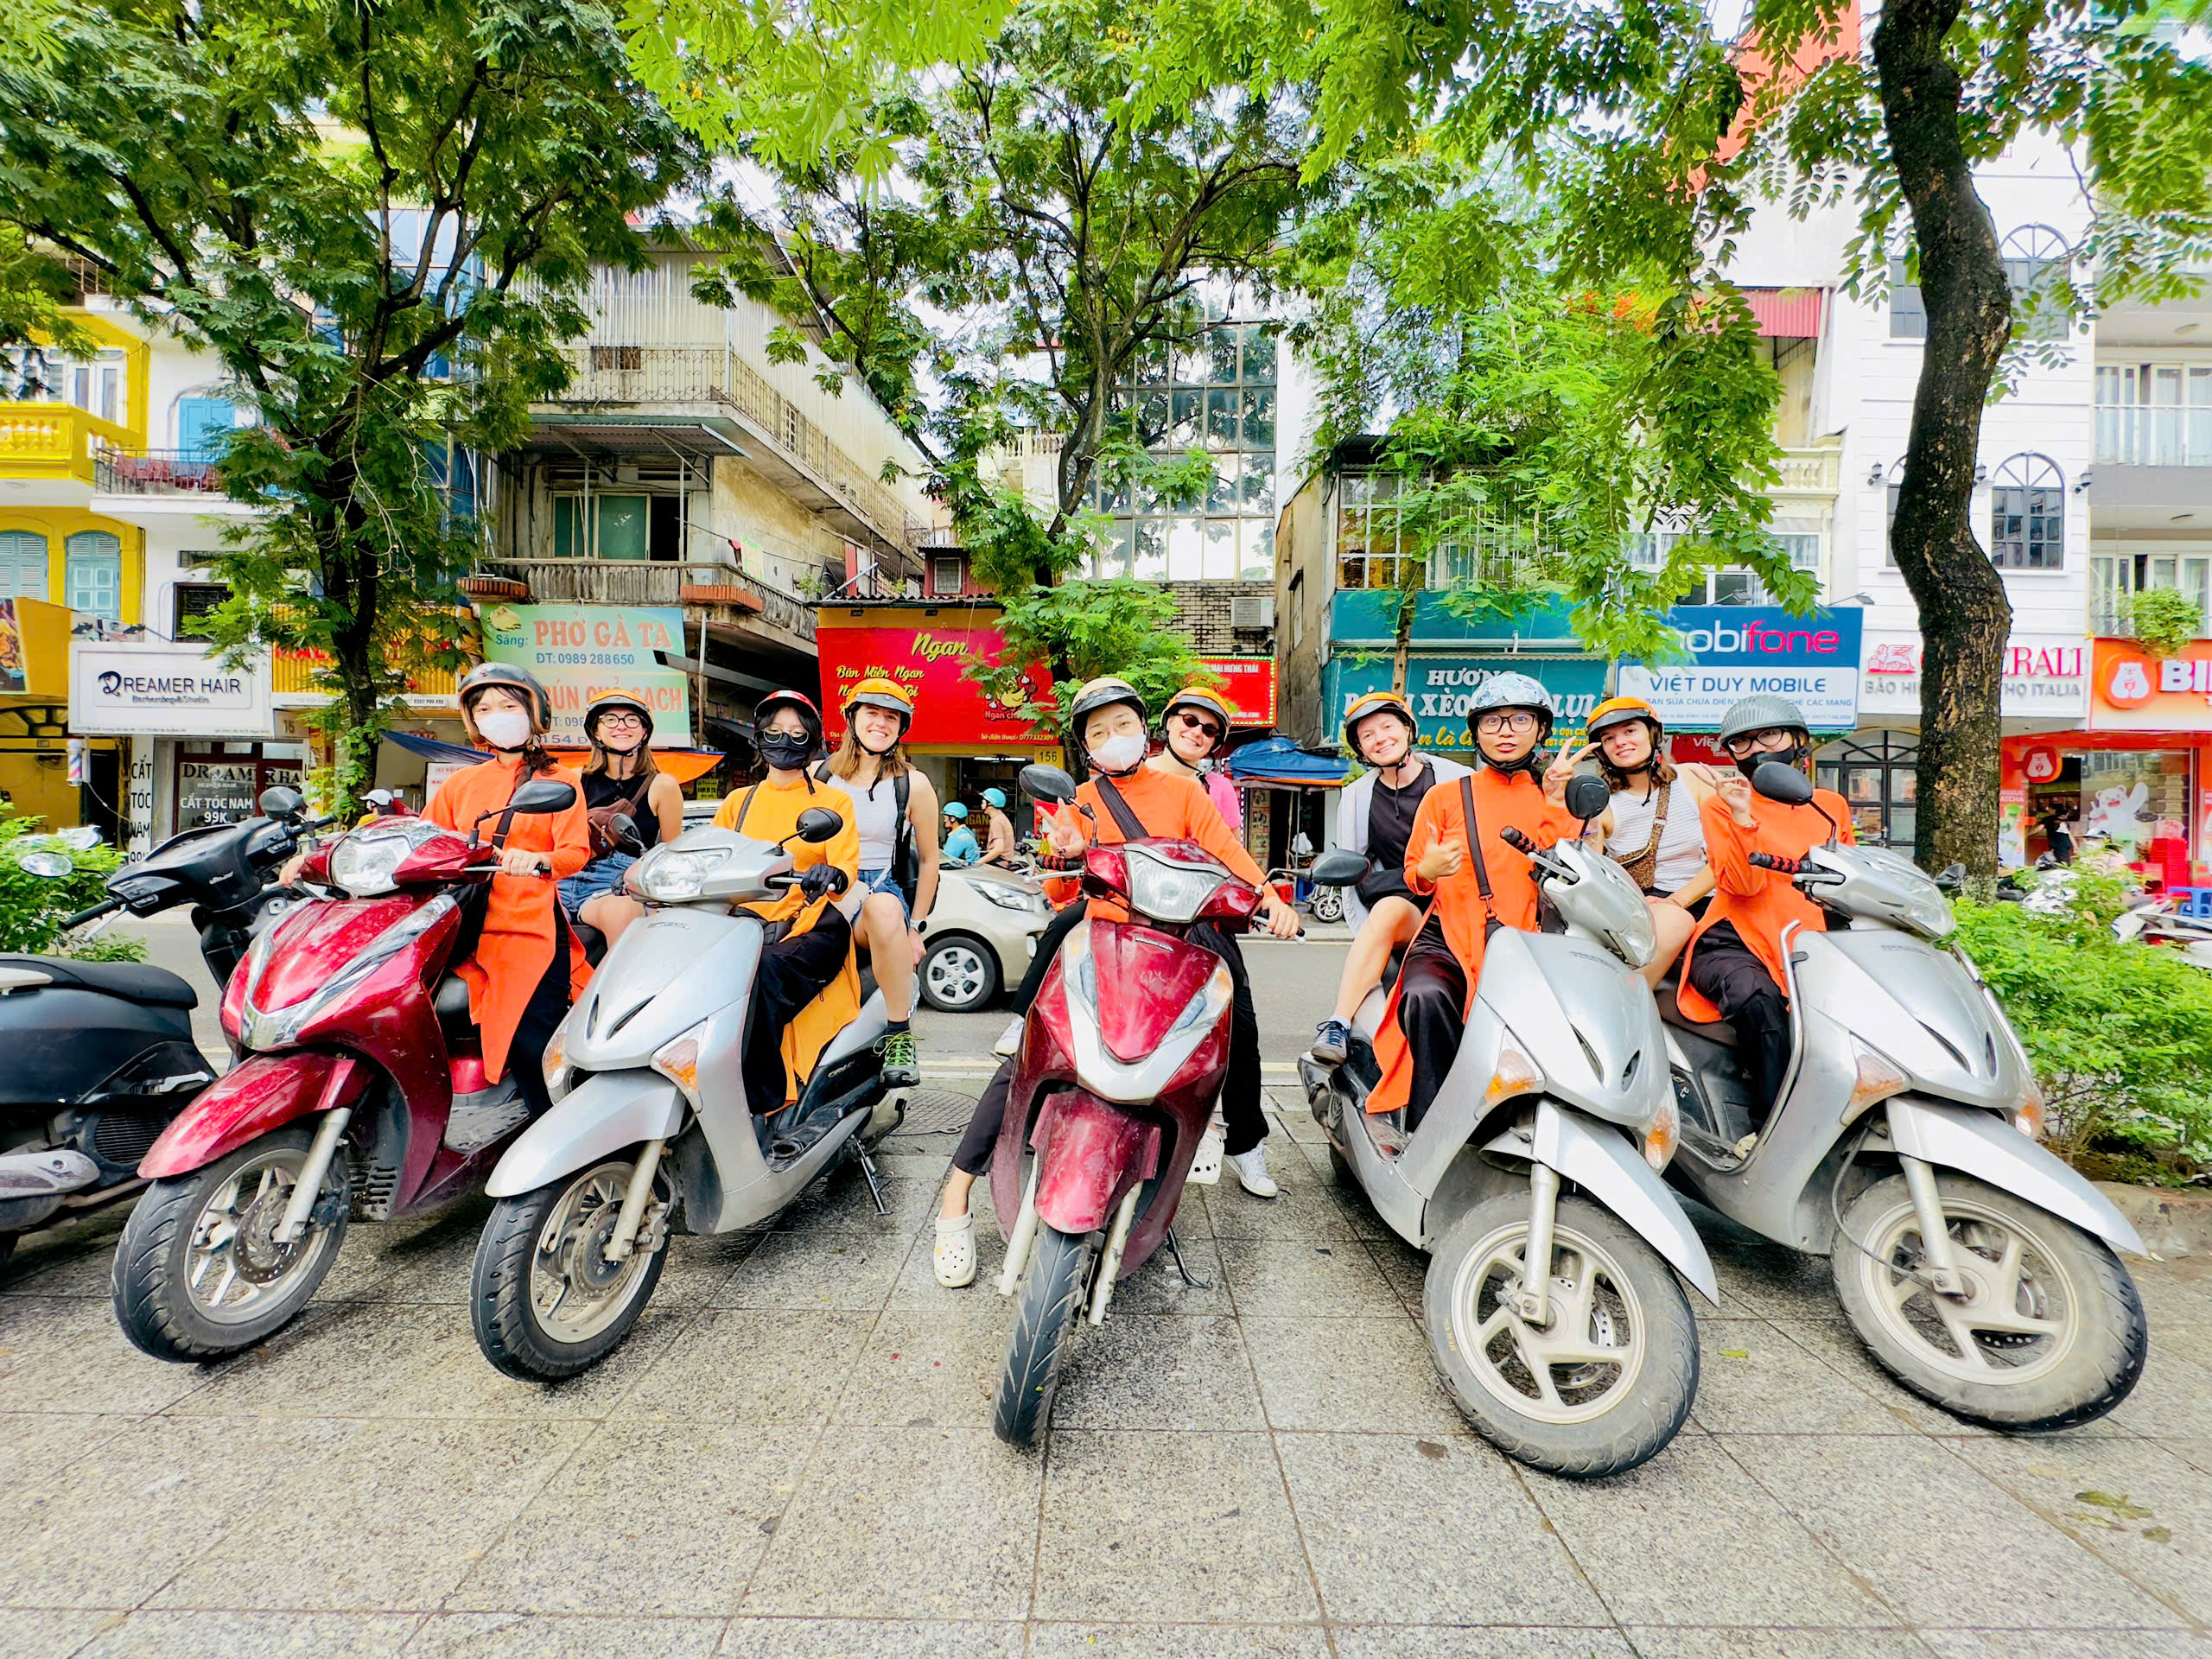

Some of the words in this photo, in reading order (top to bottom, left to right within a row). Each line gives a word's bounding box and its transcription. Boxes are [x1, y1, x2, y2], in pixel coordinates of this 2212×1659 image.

[534, 610, 588, 647] PHỞ
[594, 613, 631, 648] GÀ
[638, 621, 673, 649] TA
[1679, 620, 1840, 653] obifone
[495, 634, 529, 648] Sáng:
[911, 632, 969, 662] Ngan
[536, 652, 556, 664] ĐT:
[557, 652, 588, 664] 0989
[894, 664, 925, 682] Ngan
[1427, 666, 1517, 687] HƯƠN
[2161, 659, 2212, 692] BI
[200, 677, 242, 694] HAIR
[1649, 673, 1697, 696] VIỆT
[1702, 677, 1744, 692] DUY
[1751, 677, 1826, 693] MOBILE
[2032, 683, 2081, 698] ITALIA
[542, 734, 572, 744] 154
[131, 754, 152, 779] CẮT
[1039, 751, 1058, 762] 156
[183, 764, 276, 785] DRAMR
[130, 788, 151, 810] TÓC
[180, 791, 203, 810] CẮT
[205, 793, 227, 810] TÓC
[228, 798, 253, 810] NAM
[204, 811, 227, 823] 99K
